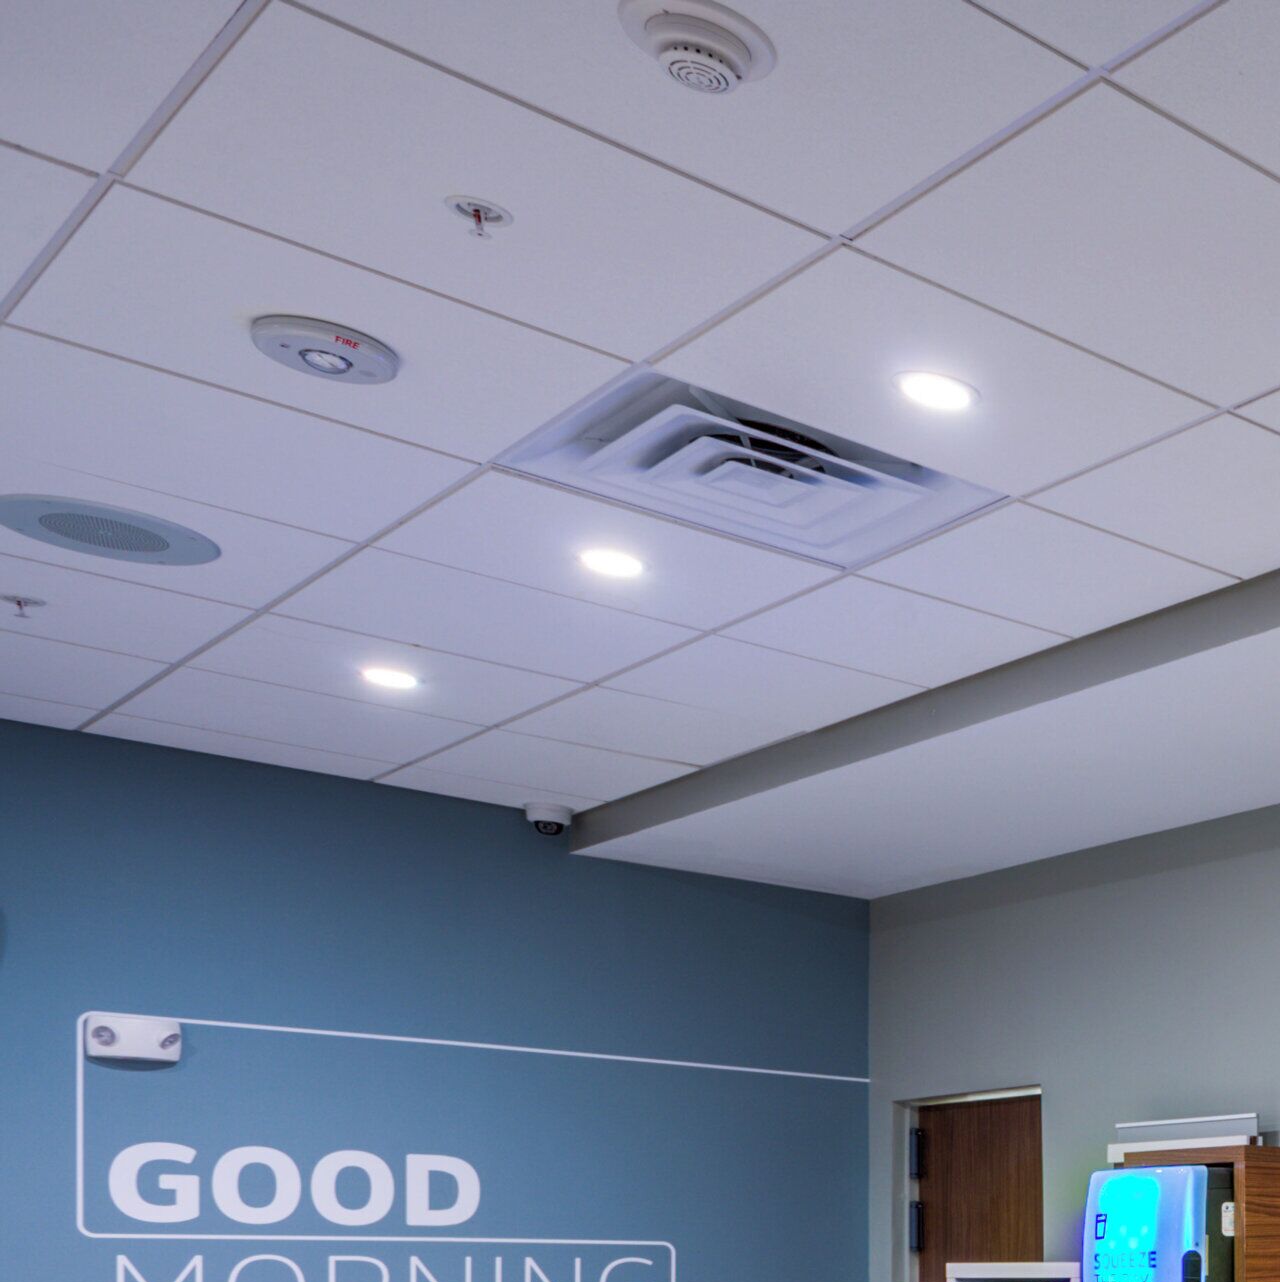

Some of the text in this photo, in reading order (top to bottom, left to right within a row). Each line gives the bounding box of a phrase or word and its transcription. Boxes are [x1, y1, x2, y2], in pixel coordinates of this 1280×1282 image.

[335, 335, 360, 350] FIRE
[108, 1141, 481, 1227] GOOD
[1094, 1251, 1157, 1270] SQUEEZE
